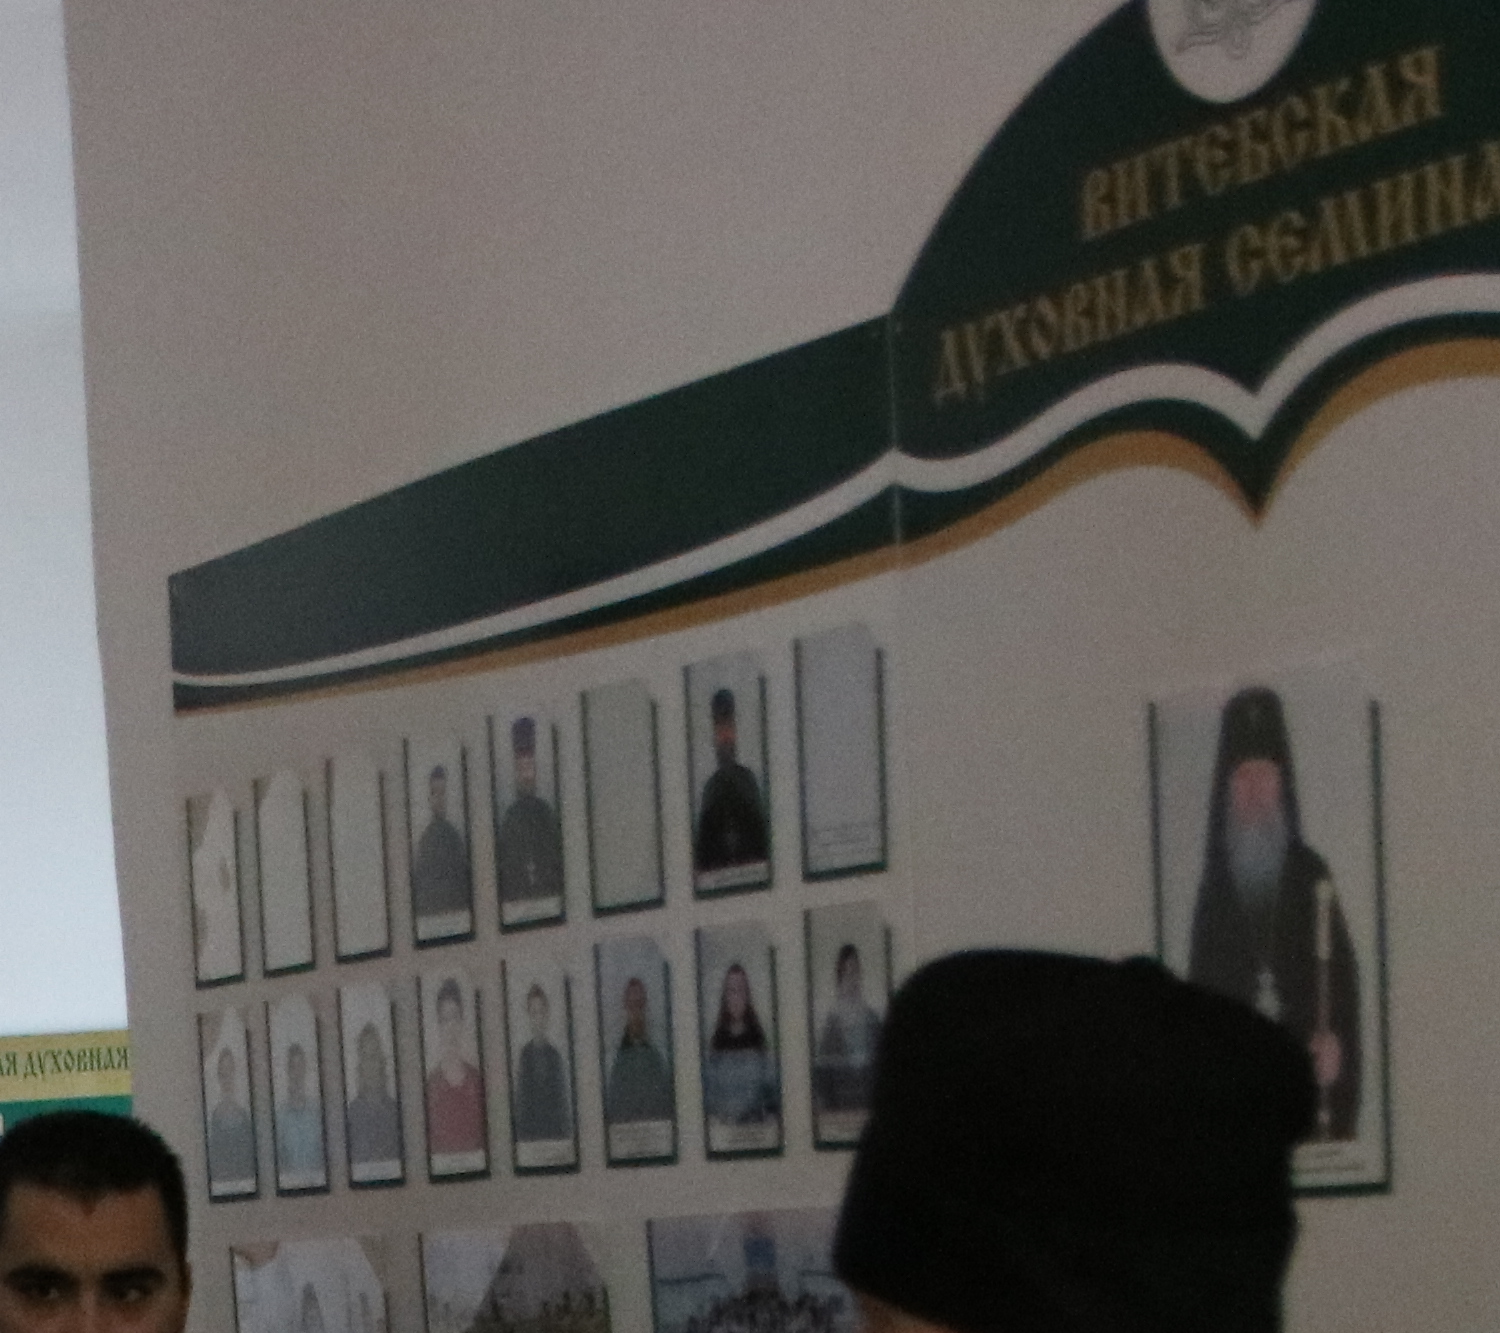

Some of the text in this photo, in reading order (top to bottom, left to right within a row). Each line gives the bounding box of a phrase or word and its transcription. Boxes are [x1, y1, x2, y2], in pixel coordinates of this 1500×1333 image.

[1079, 43, 1445, 241] ВИТЕБСКАЯ
[935, 242, 1206, 402] ДУХОВНАЯ
[23, 1046, 129, 1080] ДУХОВНАЯ
